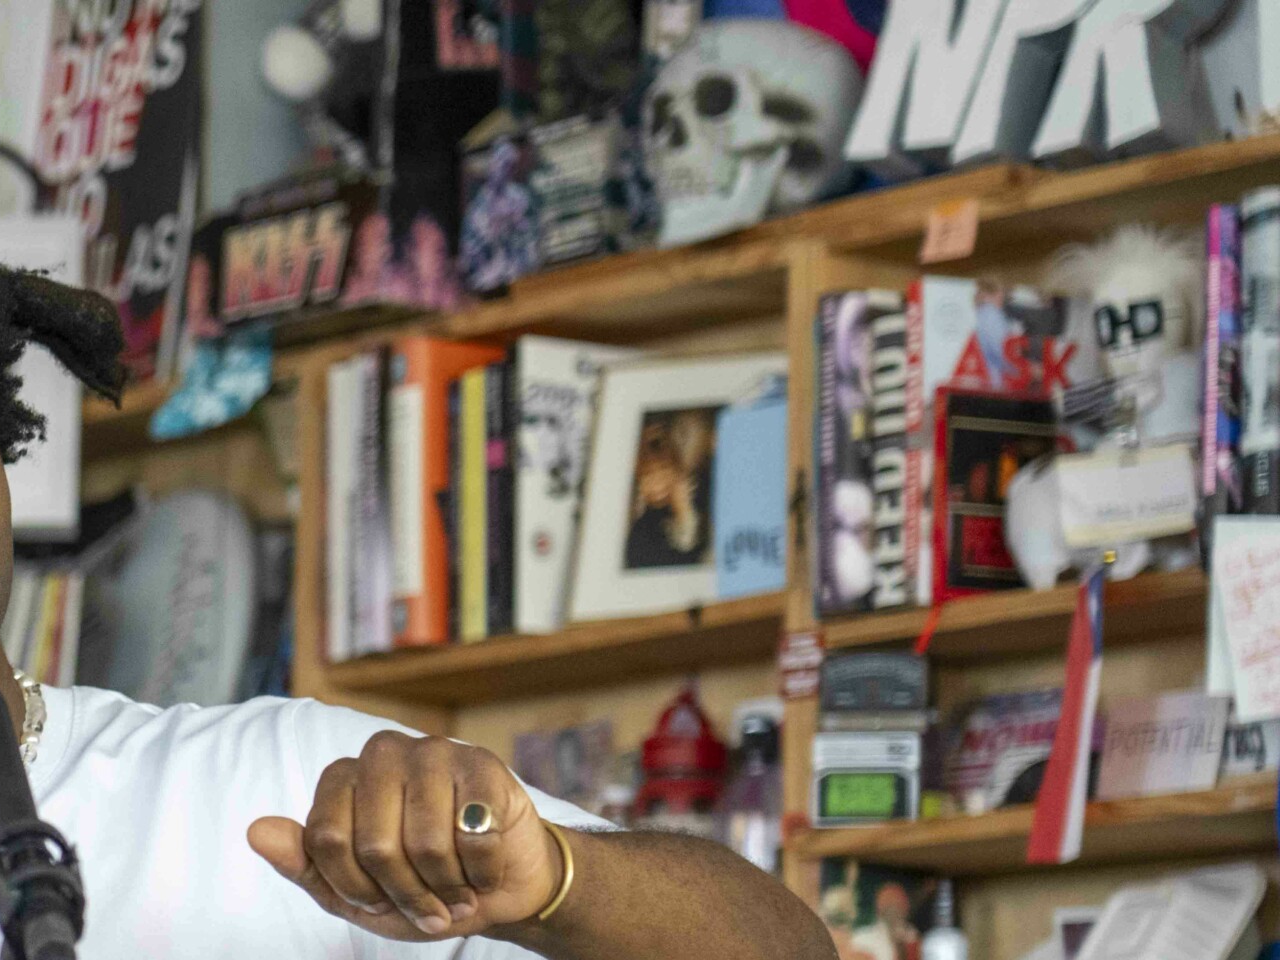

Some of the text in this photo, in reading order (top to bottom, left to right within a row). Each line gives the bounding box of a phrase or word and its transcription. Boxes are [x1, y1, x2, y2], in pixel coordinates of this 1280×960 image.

[47, 14, 187, 110] DIGAS
[843, 0, 1161, 163] NPR
[36, 84, 144, 184] QUE
[223, 202, 350, 322] KISS
[951, 331, 1079, 391] ASK
[1108, 717, 1221, 756] POTENTIAL
